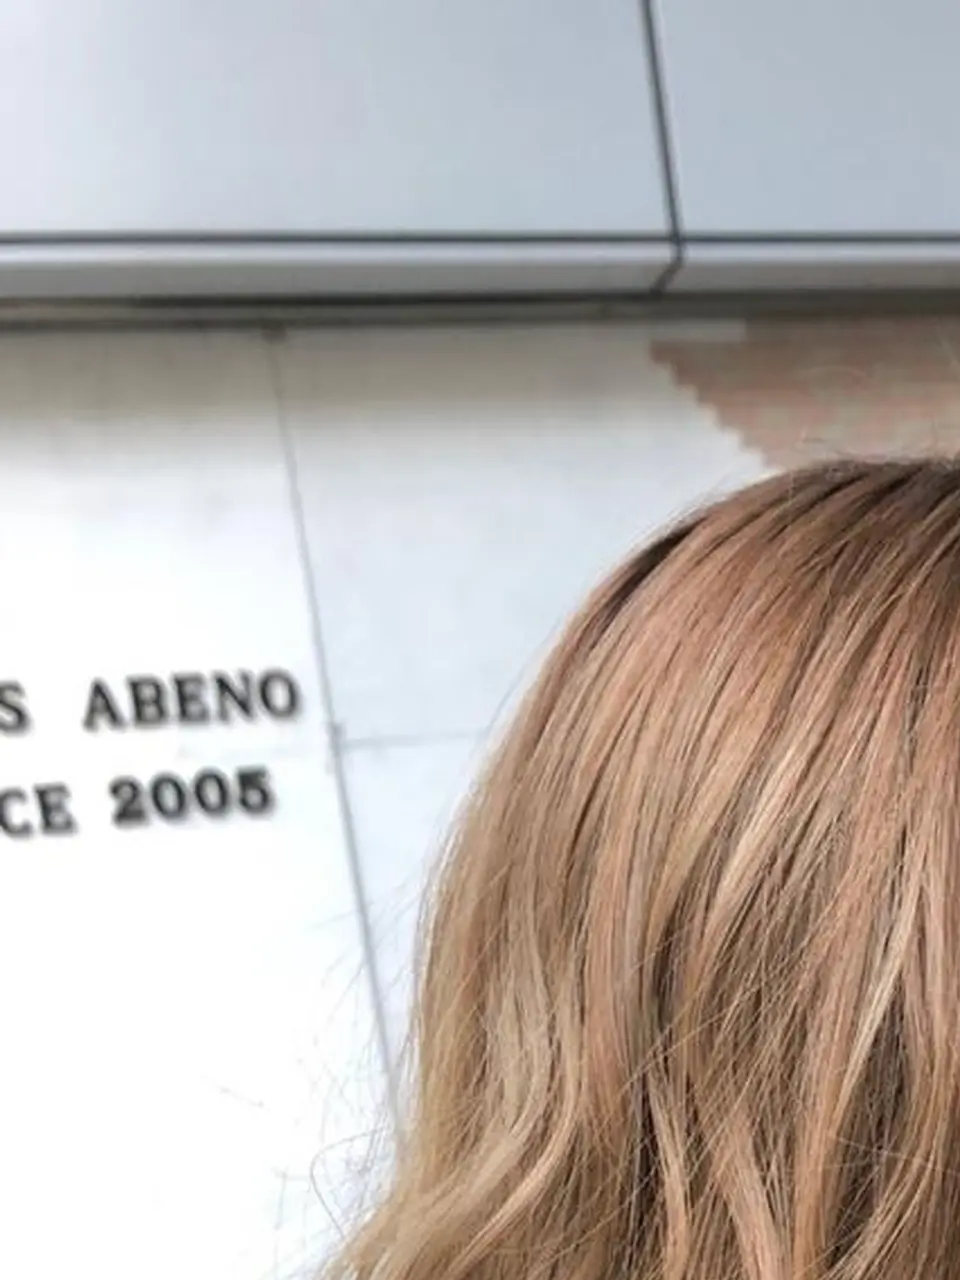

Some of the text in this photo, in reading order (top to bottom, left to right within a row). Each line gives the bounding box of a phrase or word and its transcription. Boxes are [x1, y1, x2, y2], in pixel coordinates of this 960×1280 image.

[0, 667, 301, 735] S ABENO
[0, 765, 275, 838] CE 2005
